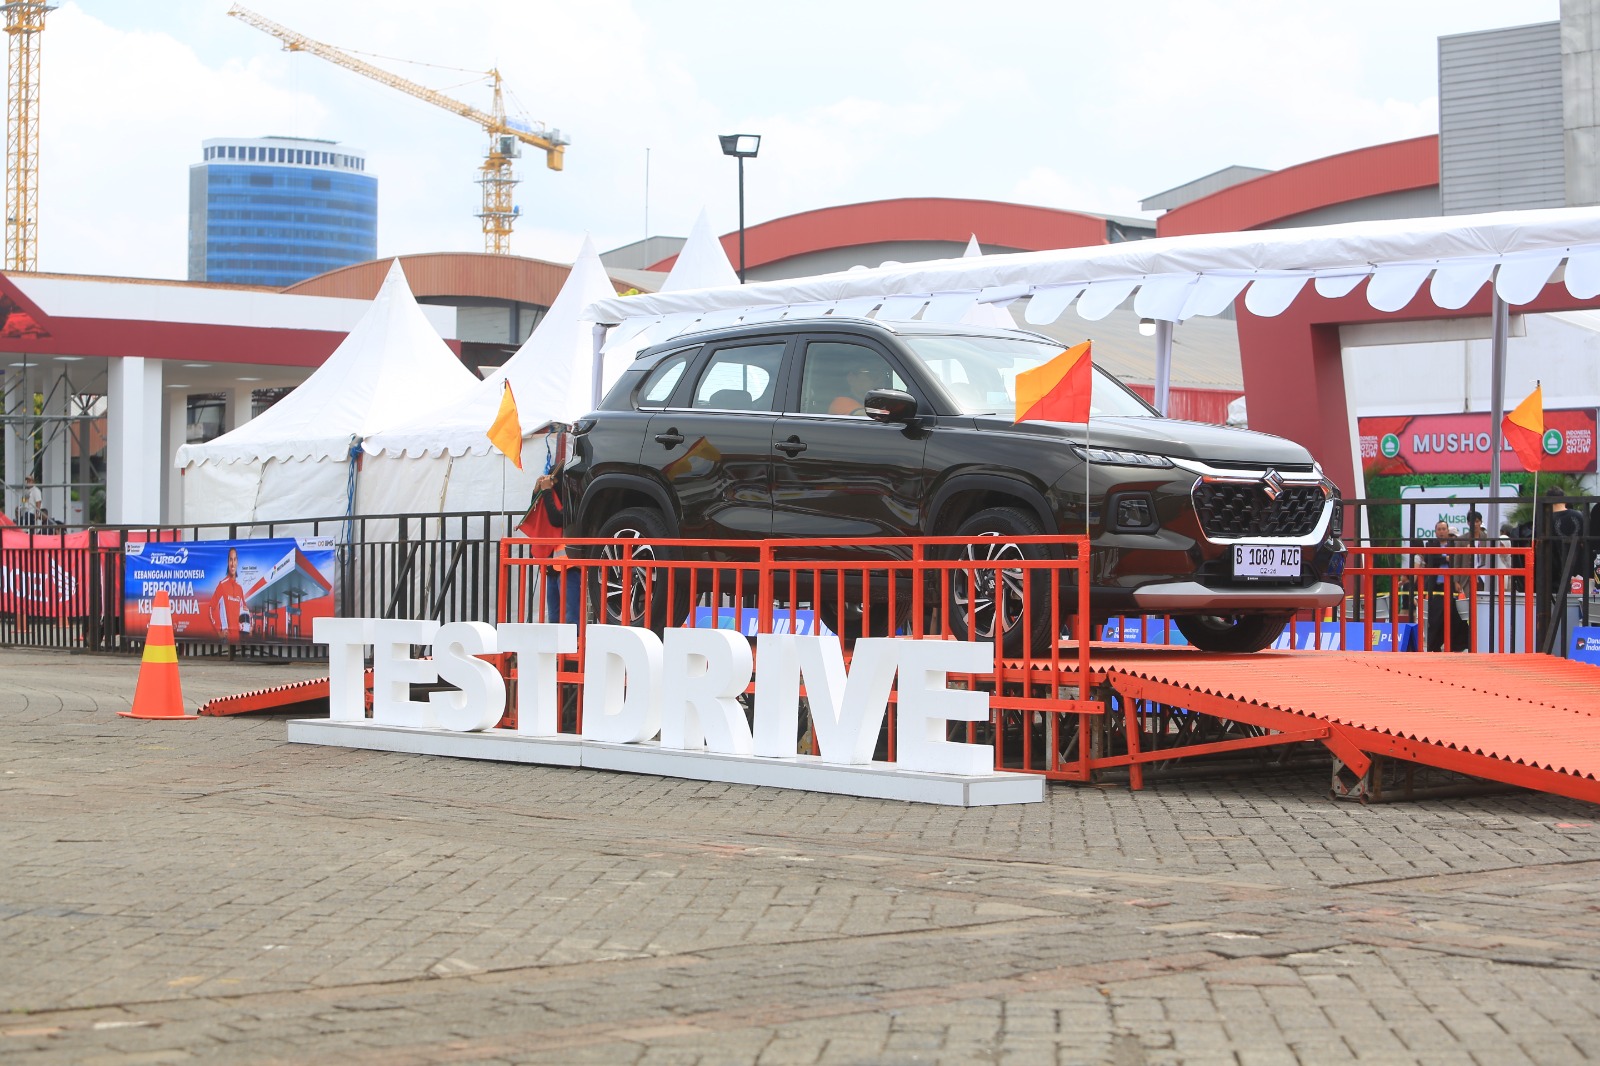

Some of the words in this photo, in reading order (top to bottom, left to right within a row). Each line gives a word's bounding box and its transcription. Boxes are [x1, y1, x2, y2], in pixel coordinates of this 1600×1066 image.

[1413, 432, 1513, 454] MUSHOL
[1566, 438, 1592, 446] MOTOR
[1566, 445, 1591, 454] SHOW
[150, 555, 183, 565] TURBO
[1236, 547, 1243, 565] B
[1249, 548, 1275, 565] 1089
[1280, 549, 1300, 566] AZC
[134, 570, 173, 580] KEBANGGAAN
[173, 569, 205, 579] INDONESIA
[142, 581, 194, 597] PERFORMA
[169, 599, 200, 614] DUNIA
[1380, 633, 1403, 642] PLN
